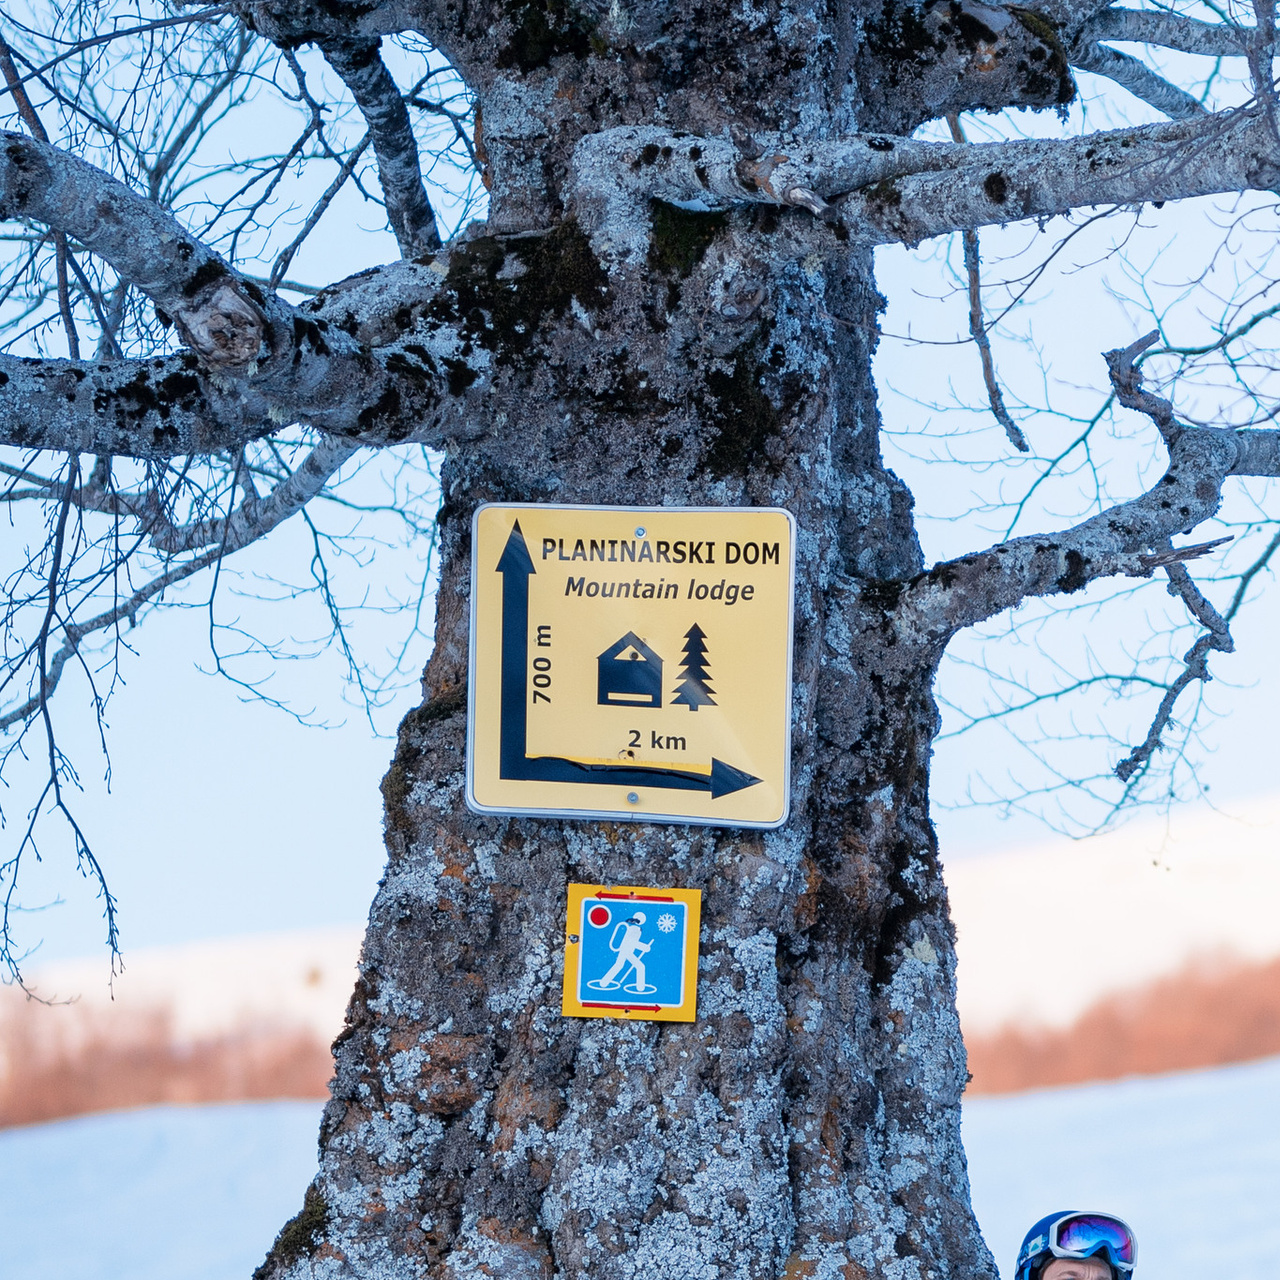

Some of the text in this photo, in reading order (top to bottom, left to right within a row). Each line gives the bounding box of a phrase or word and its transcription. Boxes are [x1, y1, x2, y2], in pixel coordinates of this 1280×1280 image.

[542, 538, 780, 565] PLANINARSKI DOM
[564, 576, 755, 605] Mountain lodge
[532, 625, 552, 704] 700 m
[628, 729, 686, 750] 2 km
